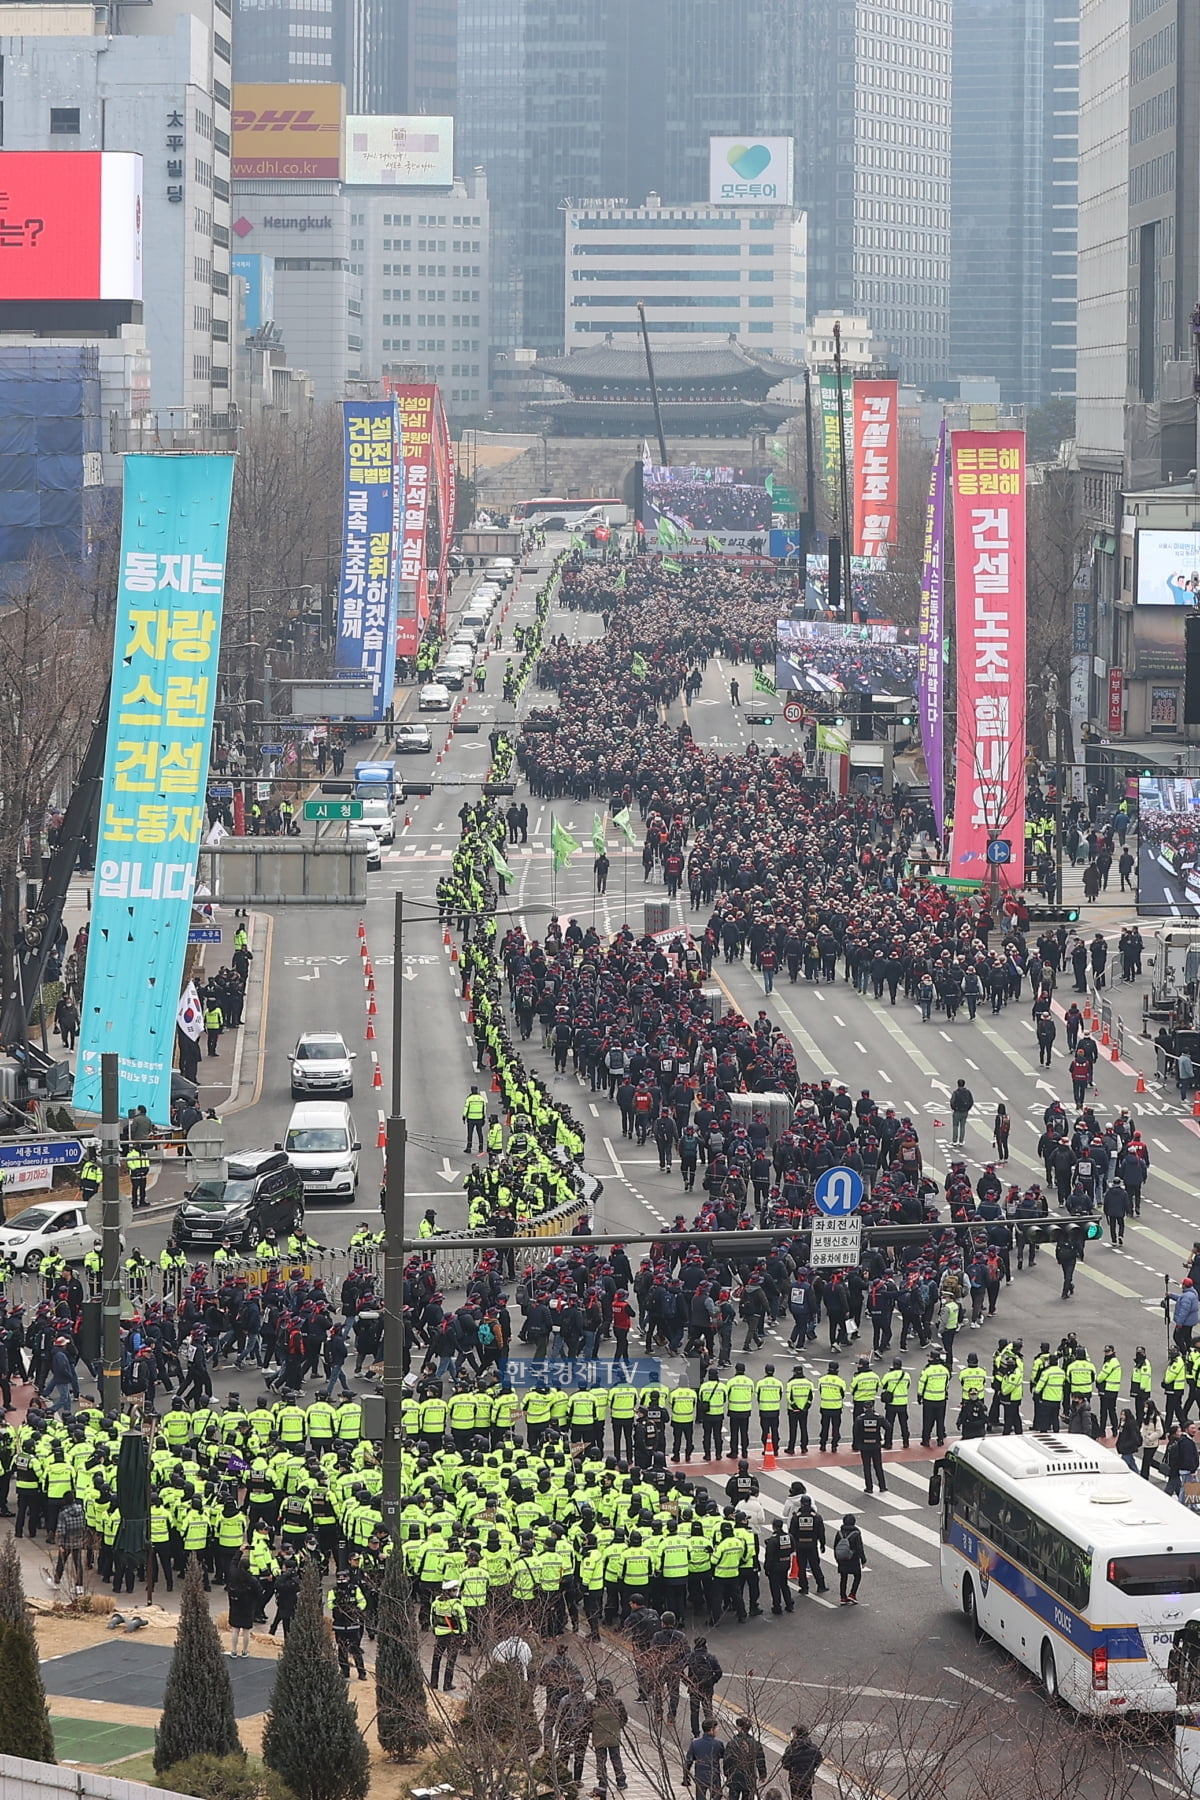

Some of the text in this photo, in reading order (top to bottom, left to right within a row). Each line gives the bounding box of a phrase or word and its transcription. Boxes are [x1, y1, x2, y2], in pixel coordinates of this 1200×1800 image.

[231, 110, 320, 131] DHL
[721, 184, 777, 198] 모두투어
[263, 216, 332, 232] Heungkuk
[348, 416, 392, 441] 건설
[349, 442, 392, 467] 안전
[861, 397, 890, 500] 건설노조
[957, 448, 1019, 470] 든든해
[349, 467, 392, 484] 특별법
[958, 473, 1020, 495] 응원해
[401, 465, 427, 581] 윤석열 심판
[124, 551, 223, 595] 동지는
[341, 490, 368, 639] 금속노조가 함께
[971, 508, 1009, 683] 건설노조
[125, 609, 217, 663] 자랑
[119, 674, 209, 727] 스런
[787, 707, 800, 718] 50
[1111, 681, 1121, 718] 부동산
[114, 741, 203, 793] 건설
[971, 695, 1010, 825] 힘내요
[103, 803, 202, 844] 노동자
[316, 805, 351, 817] 시청
[98, 859, 196, 900] 입니다
[16, 1146, 78, 1157] 세종대로 100
[815, 1219, 859, 1231] 좌회전시
[813, 1236, 858, 1247] 보행신호시
[1054, 1606, 1072, 1634] POLICE
